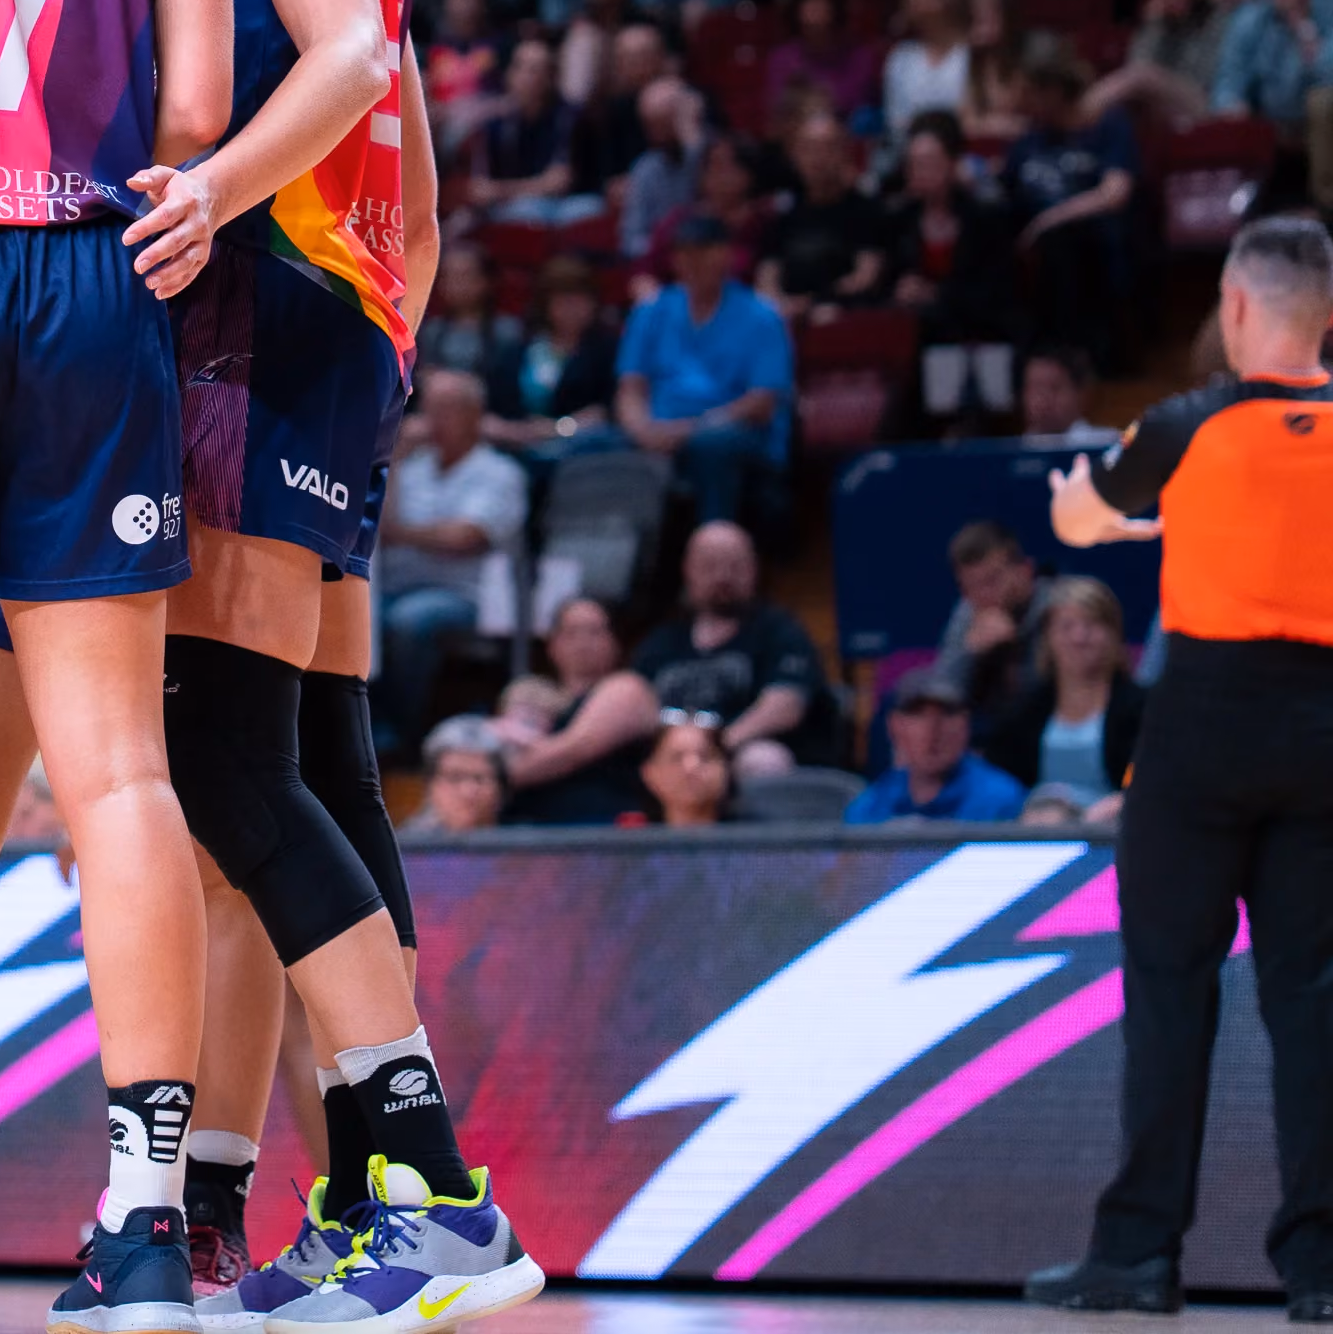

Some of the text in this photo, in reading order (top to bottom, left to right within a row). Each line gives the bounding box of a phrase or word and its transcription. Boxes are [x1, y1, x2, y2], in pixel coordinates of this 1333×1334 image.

[363, 196, 403, 229] HO
[363, 224, 404, 256] ASS
[279, 458, 349, 511] VALO
[162, 492, 182, 520] fre
[384, 1093, 442, 1114] WNBL
